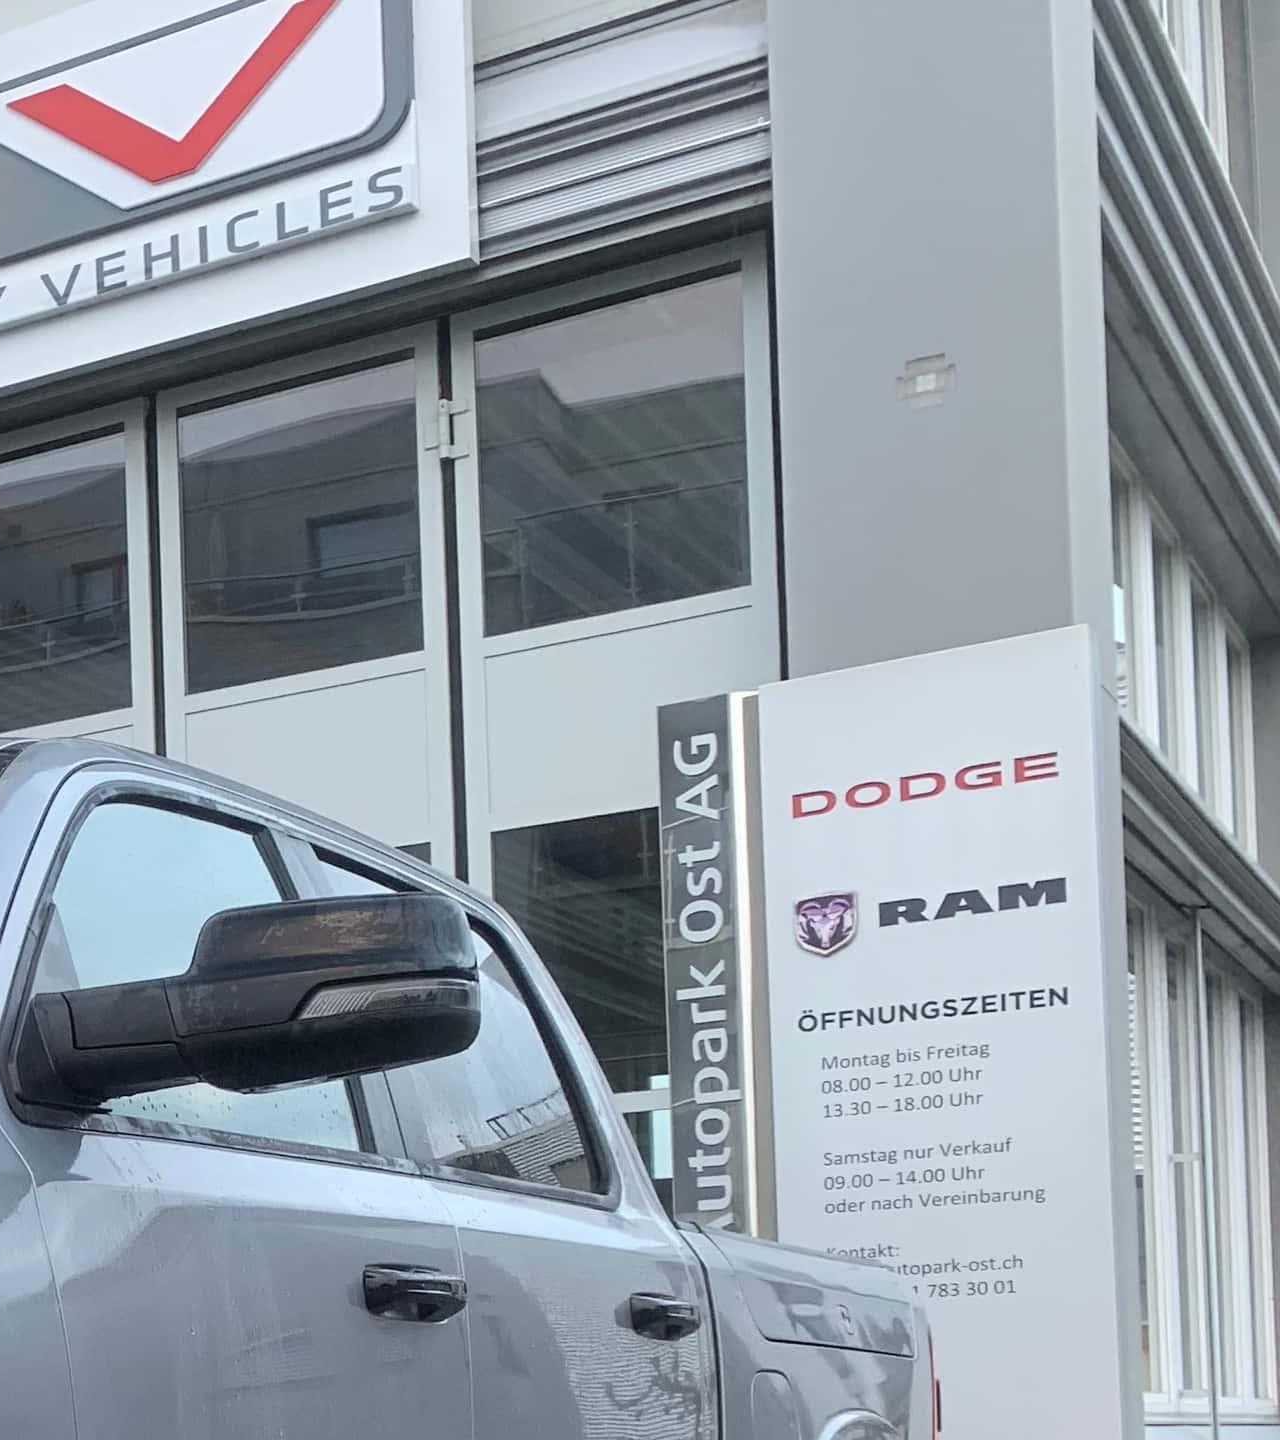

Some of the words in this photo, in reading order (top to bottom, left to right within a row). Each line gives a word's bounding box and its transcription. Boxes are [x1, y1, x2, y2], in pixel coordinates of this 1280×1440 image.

[41, 166, 404, 307] VEHICLES
[673, 732, 721, 820] AG
[791, 751, 1060, 819] DODGE
[677, 841, 724, 943] Ost
[878, 877, 1068, 928] RAM
[797, 986, 1070, 1033] ÖFFNUNGSZEITEN
[821, 1052, 891, 1071] Montag
[896, 1049, 921, 1064] bis
[927, 1043, 991, 1059] Freitag
[821, 1076, 872, 1095] 08.00
[893, 1070, 943, 1088] 12.00
[949, 1067, 984, 1083] Uhr
[823, 1101, 872, 1119] 13.30
[894, 1094, 944, 1113] 18.00
[949, 1092, 984, 1108] Uhr
[823, 1150, 898, 1167] Samstag
[903, 1147, 935, 1160] nur
[939, 1137, 1013, 1158] Verkauf
[824, 1173, 873, 1191] 09.00
[896, 1168, 946, 1186] 14.00
[951, 1166, 985, 1182] Uhr
[824, 1198, 866, 1214] oder
[871, 1194, 913, 1211] nach
[918, 1188, 1046, 1208] Vereinbarung
[927, 1282, 960, 1298] 783
[967, 1280, 988, 1296] 30
[993, 1279, 1017, 1294] 01
